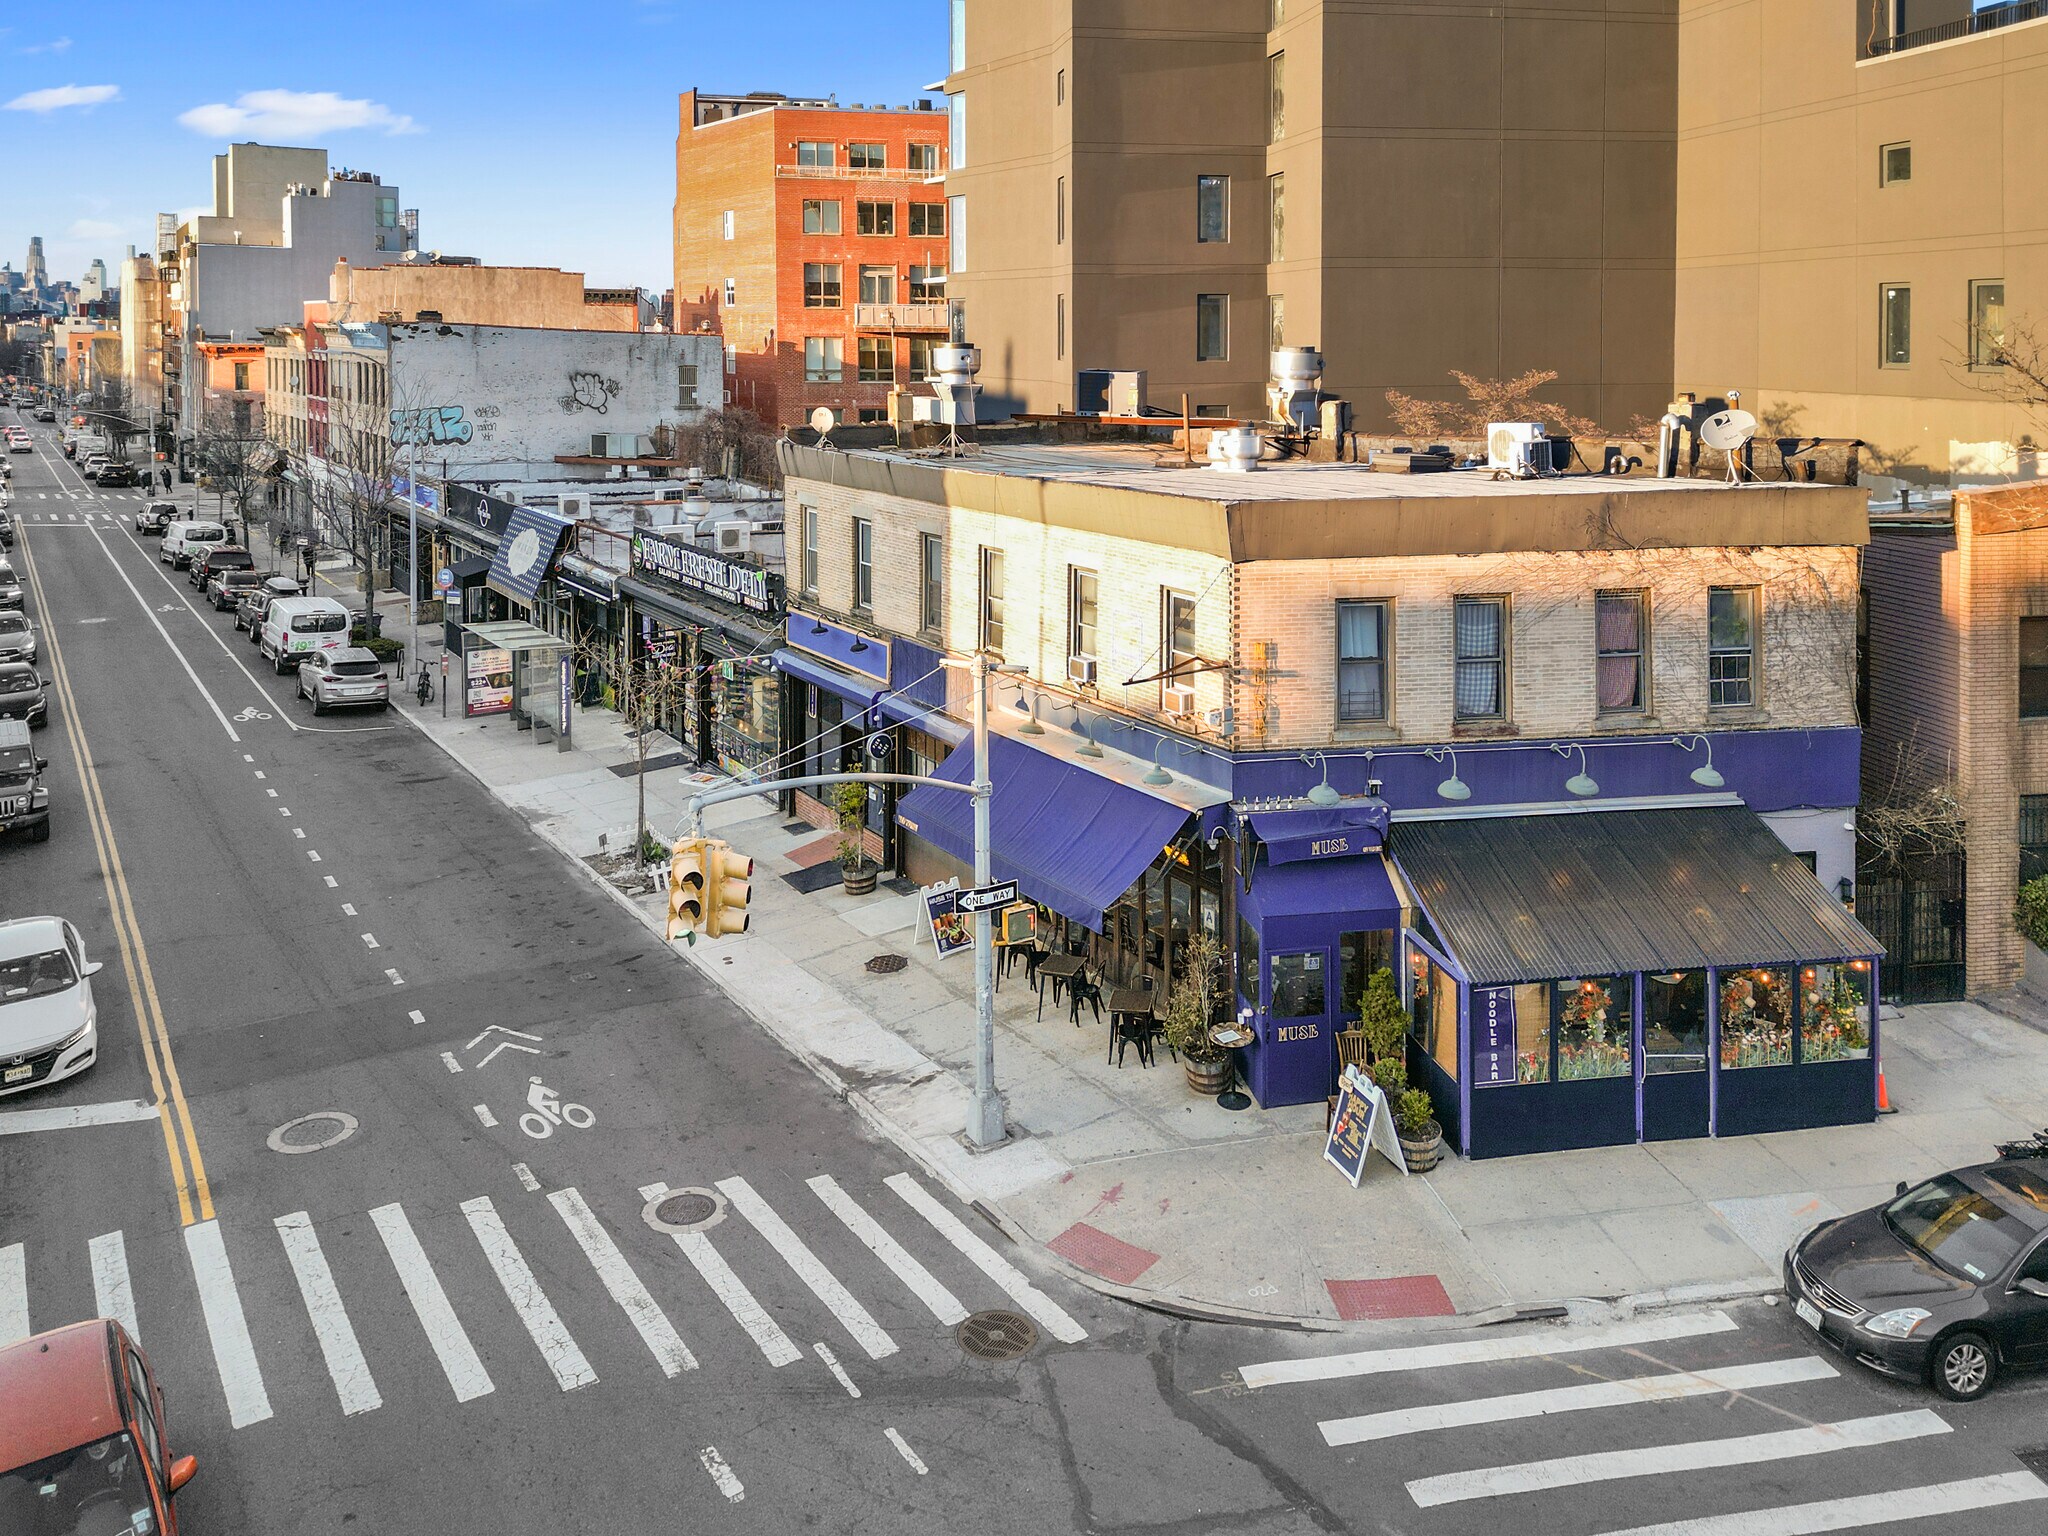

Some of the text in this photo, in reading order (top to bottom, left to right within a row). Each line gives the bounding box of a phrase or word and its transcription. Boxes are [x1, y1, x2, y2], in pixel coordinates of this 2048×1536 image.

[643, 537, 769, 601] FARM FRESH DELI
[704, 583, 723, 597] ORGANIC
[723, 589, 735, 601] FOOD
[1311, 838, 1349, 856] MUSE
[965, 889, 1011, 906] ONE WAY
[1206, 911, 1213, 924] A
[1278, 1024, 1319, 1042] MUSE
[1488, 991, 1499, 1081] NOODLE BAR
